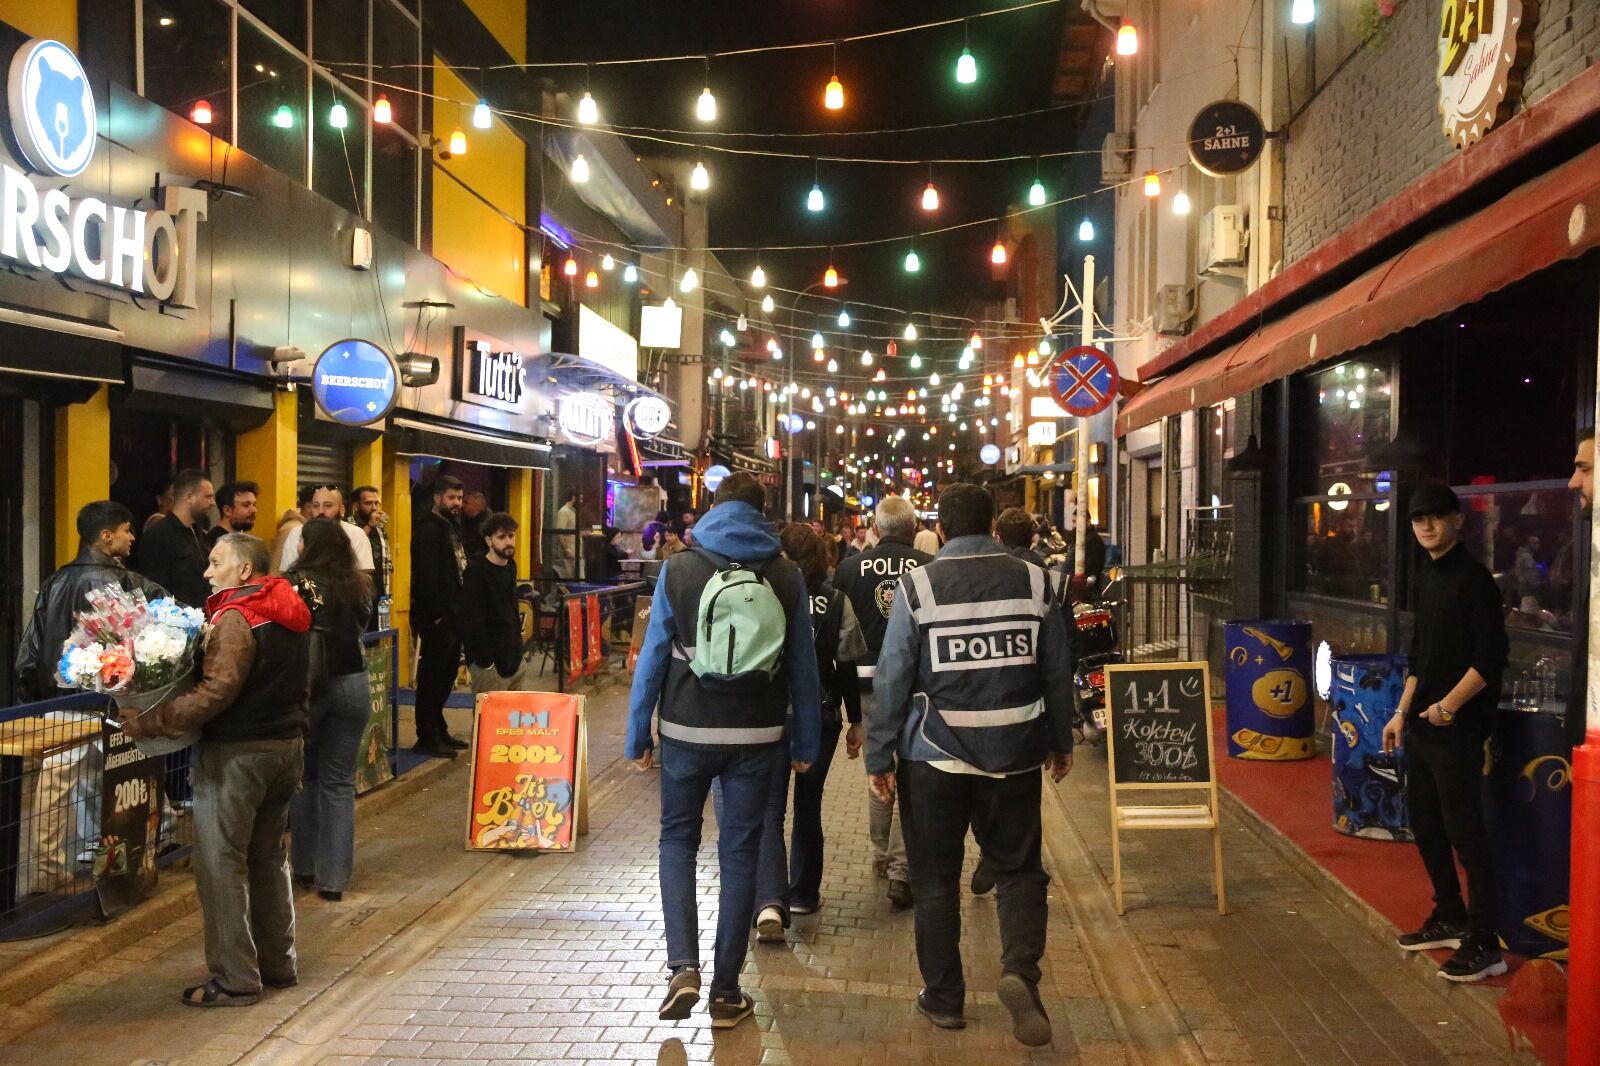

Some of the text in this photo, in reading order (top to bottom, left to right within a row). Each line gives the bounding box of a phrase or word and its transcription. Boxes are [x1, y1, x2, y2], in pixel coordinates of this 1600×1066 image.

[1458, 43, 1499, 104] Sahne
[1215, 125, 1237, 137] 2+1
[1204, 136, 1250, 151] SAHNE
[476, 340, 527, 403] Tutti's
[321, 374, 389, 390] BEERSCHOT
[1123, 679, 1181, 714] 1+1
[508, 710, 550, 729] 1+1
[109, 731, 124, 748] EFES
[495, 728, 560, 736] EFES MALT
[1123, 717, 1197, 746] Kokteyl
[512, 774, 545, 802] It's
